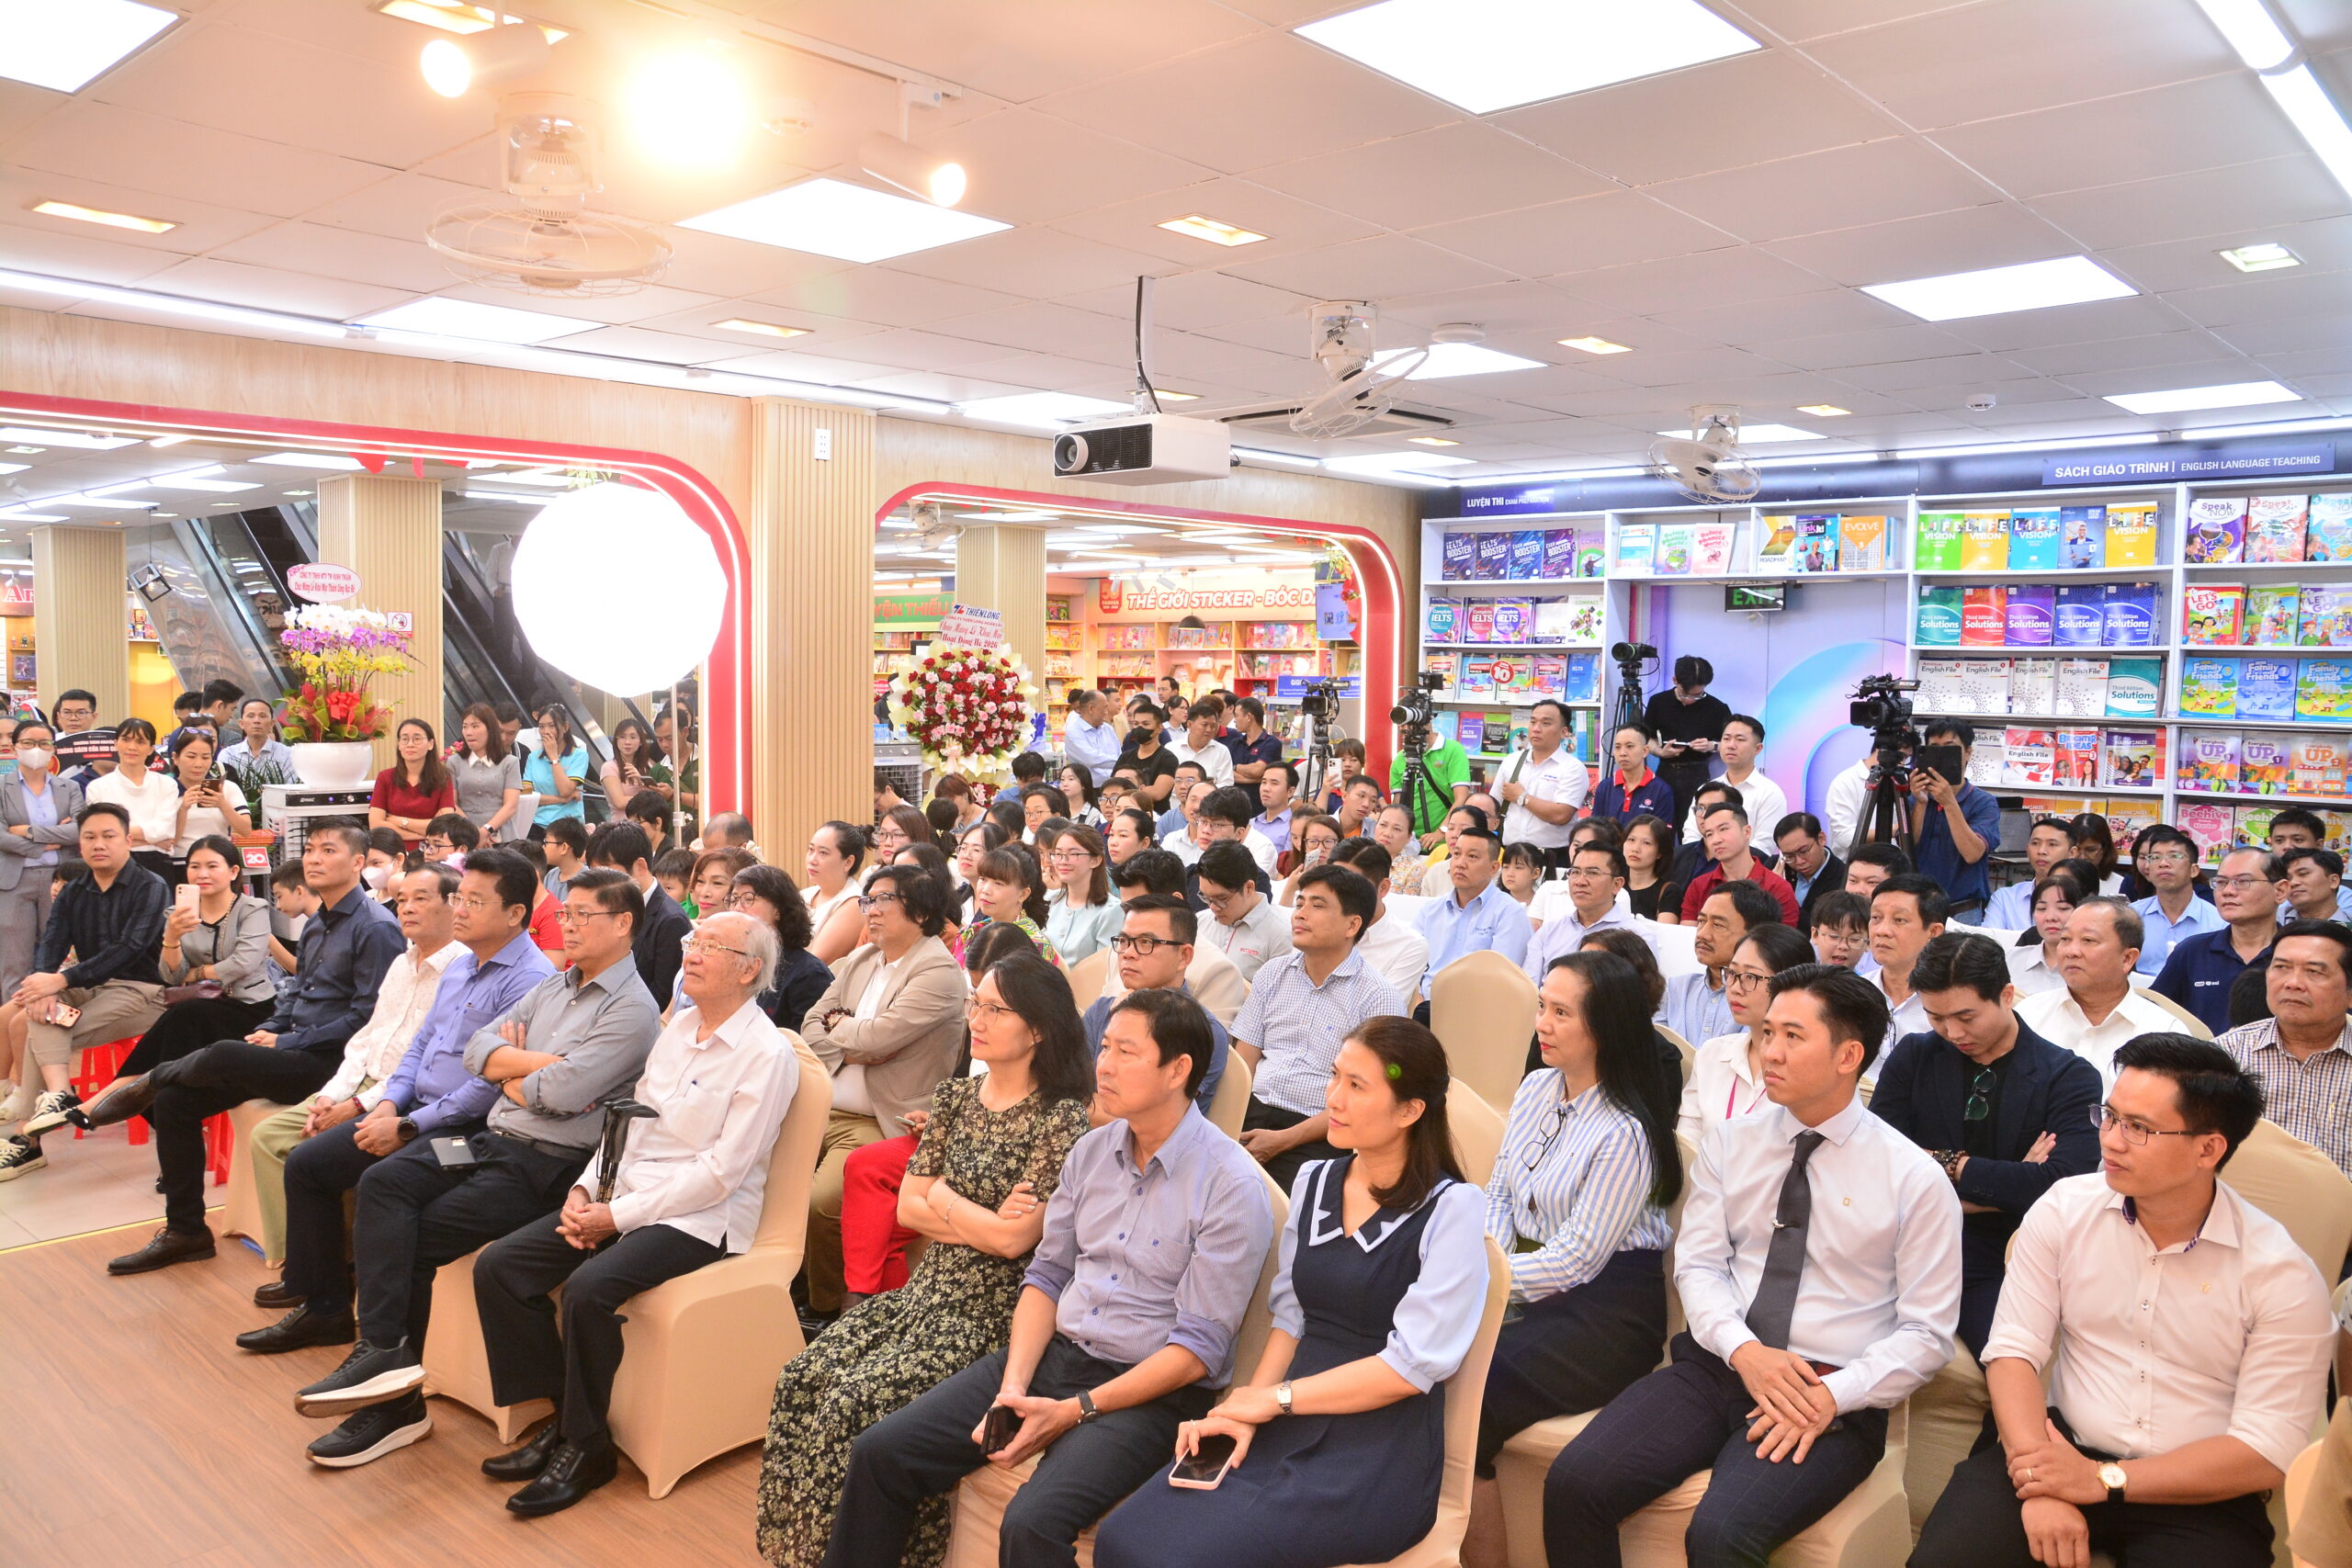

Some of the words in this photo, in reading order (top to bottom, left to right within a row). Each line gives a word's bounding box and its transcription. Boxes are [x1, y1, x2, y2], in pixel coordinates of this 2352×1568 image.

[2181, 461, 2219, 471] ENGLISH
[2221, 458, 2270, 469] LANGUAGE
[2272, 455, 2321, 466] TEACHING
[2054, 466, 2089, 478] SÁCH
[2092, 463, 2125, 476] GIÁO
[2129, 461, 2168, 474] TRÌNH
[1466, 496, 1490, 508] LUYỆN
[1491, 496, 1504, 506] THI
[2201, 502, 2233, 511] Speak
[2015, 519, 2057, 531] LIFE
[2109, 514, 2154, 527] LIFE
[1845, 522, 1880, 532] EVOLVE
[1920, 521, 1963, 532] LIFE
[1965, 521, 2007, 532] LIFE
[2113, 527, 2148, 536] VISION
[2019, 531, 2052, 539] VISION
[1446, 545, 1472, 558] BOOSTER
[1480, 545, 1507, 558] BOOSTER
[1514, 544, 1541, 558] BOOSTER
[1548, 543, 1571, 557] BOOSTER
[1127, 586, 1157, 610] THẾ
[1158, 588, 1189, 610] GIỚI
[1190, 590, 1255, 609] STICKER
[1263, 584, 1300, 607] BÓC
[2190, 592, 2217, 604] LET'S
[905, 597, 948, 616] THIẾU
[2196, 601, 2215, 611] GO
[2312, 603, 2332, 613] GO
[1431, 614, 1452, 622] IELTS
[1472, 614, 1493, 623] IELTS
[1497, 614, 1519, 622] IELTS
[1920, 620, 1959, 628] Solutions
[1965, 620, 2004, 628] Solutions
[2008, 620, 2050, 628] Solutions
[2058, 619, 2100, 628] Solutions
[2107, 619, 2149, 628] Solutions
[2193, 662, 2222, 671] Family
[2247, 662, 2278, 671] Family
[2308, 664, 2340, 673] Family
[1494, 666, 1510, 682] 10
[2191, 671, 2223, 680] Friends
[2245, 671, 2279, 681] Friends
[2306, 673, 2341, 682] Friends
[2111, 691, 2154, 700] Solutions
[1487, 727, 1507, 735] FIRST
[2201, 744, 2226, 757] UP
[2247, 746, 2275, 760] UP
[2305, 749, 2334, 761] UP
[2181, 808, 2231, 819] Beehive
